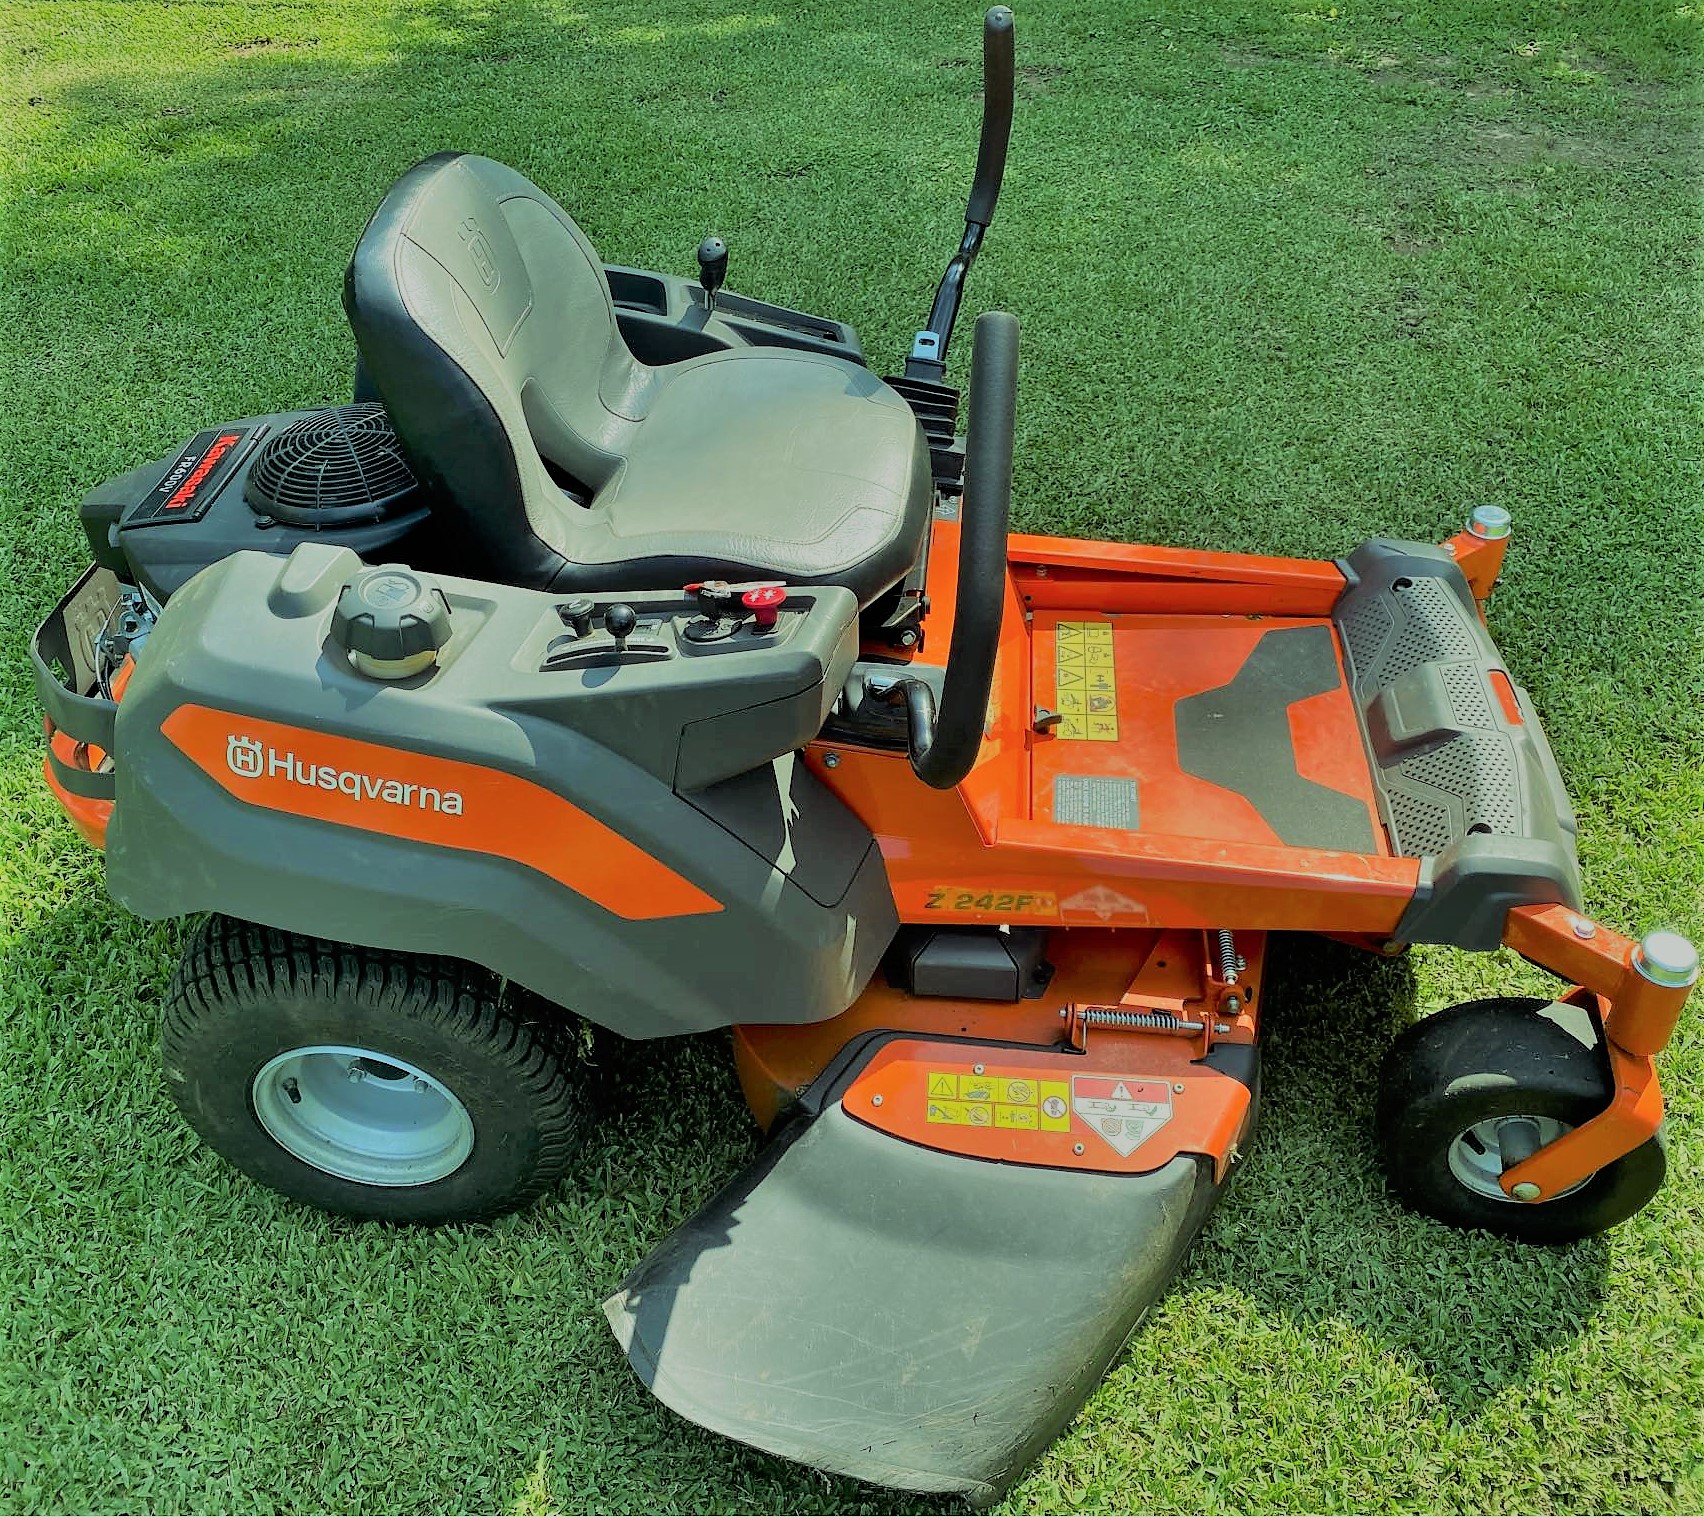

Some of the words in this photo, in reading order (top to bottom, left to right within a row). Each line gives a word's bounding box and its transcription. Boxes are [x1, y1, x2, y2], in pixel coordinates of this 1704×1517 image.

[158, 456, 197, 493] FR600V
[164, 435, 240, 509] Kawasaki
[268, 748, 463, 815] Husqvarna
[924, 893, 946, 909] Z
[954, 894, 1034, 911] 242F
